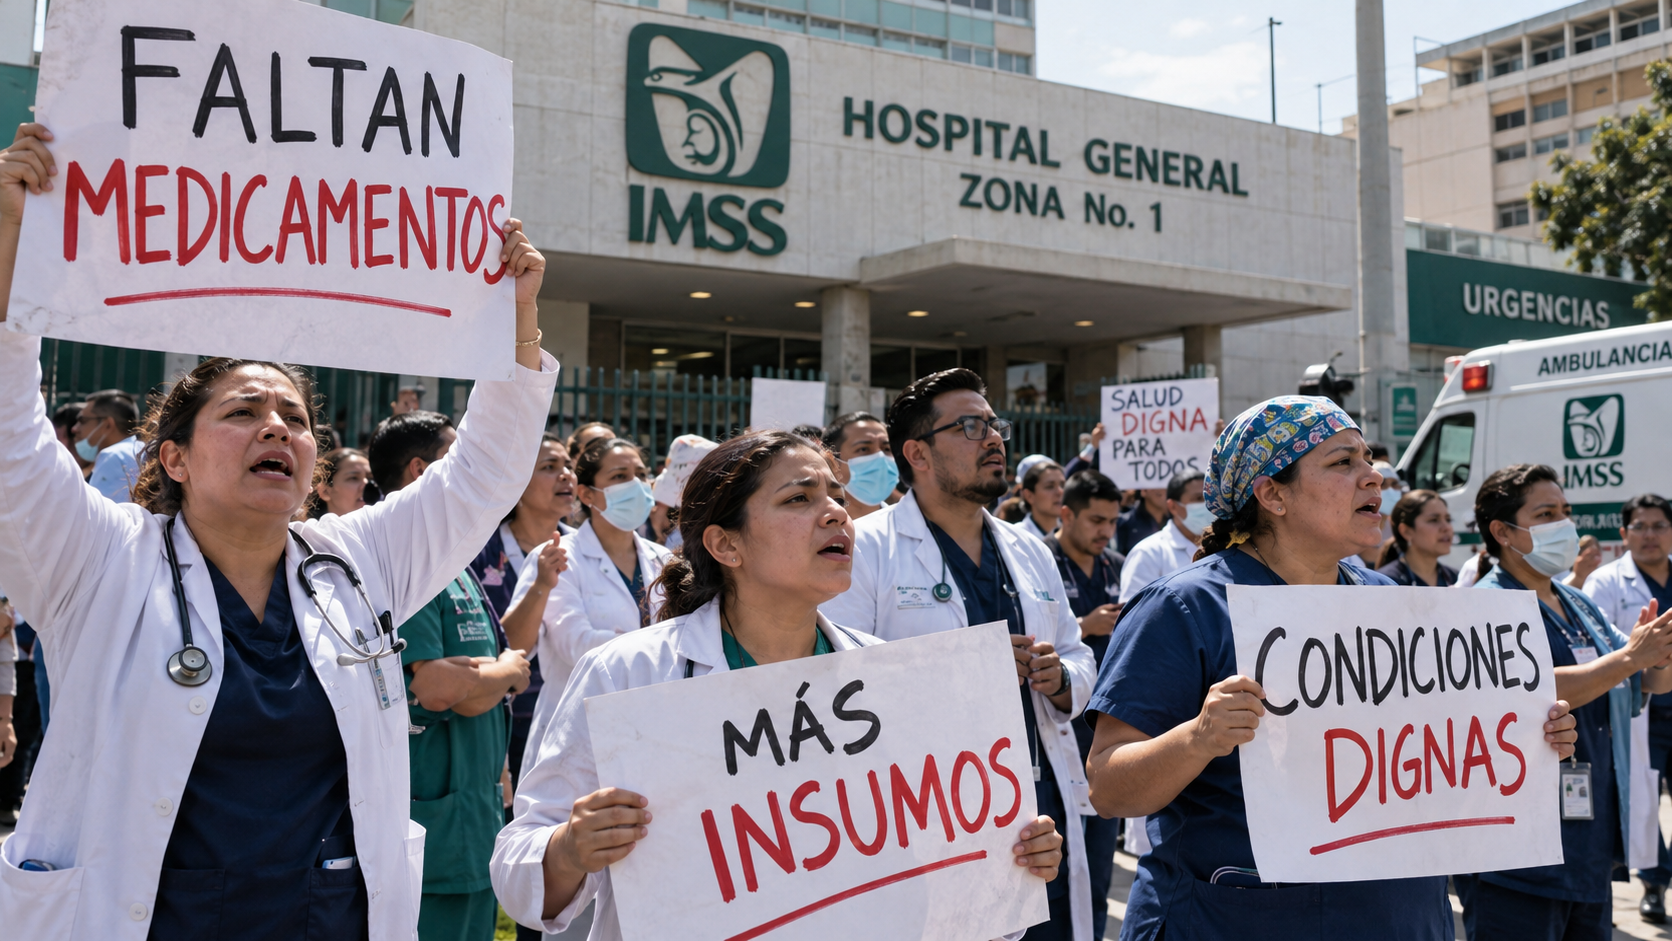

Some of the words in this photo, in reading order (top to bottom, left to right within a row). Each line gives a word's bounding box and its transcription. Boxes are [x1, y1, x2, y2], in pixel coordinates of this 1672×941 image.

[120, 24, 466, 159] FALTAN
[843, 96, 1061, 169] HOSPITAL
[1083, 138, 1249, 197] GENERAL
[63, 158, 507, 285] MEDICAMENTOS
[628, 184, 788, 257] IMSS
[959, 172, 1065, 220] ZONA
[1084, 191, 1135, 230] No.
[1149, 201, 1162, 234] 1
[1463, 283, 1610, 329] URGENCIAS
[1537, 340, 1672, 376] AMBULANCIA
[1111, 386, 1183, 412] SALUD
[1122, 407, 1208, 436] DIGNA
[1112, 437, 1166, 460] PARA
[1128, 457, 1199, 481] TODOS
[1563, 461, 1625, 490] IMSS
[1254, 621, 1541, 716] CONDICIONES
[722, 679, 881, 777] MÁS
[1323, 711, 1527, 824] DIGNAS
[700, 736, 1022, 904] INSUMOS
